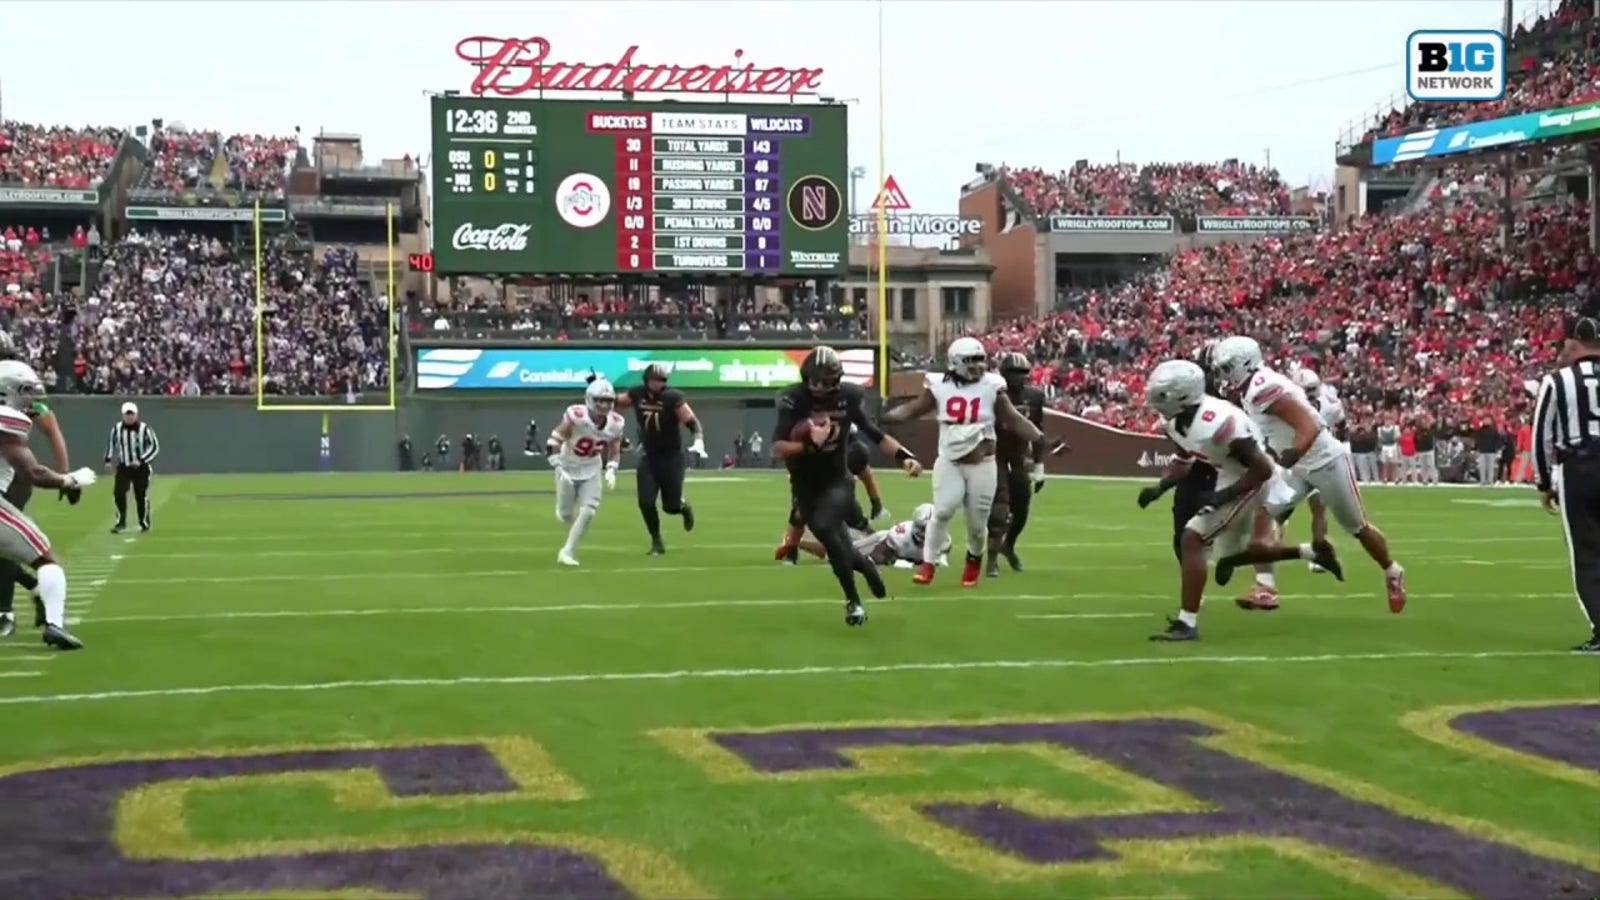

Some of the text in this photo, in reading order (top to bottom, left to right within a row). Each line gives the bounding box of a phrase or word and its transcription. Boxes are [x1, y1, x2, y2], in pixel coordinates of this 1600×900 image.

[455, 36, 823, 94] Budweiser
[446, 109, 498, 133] 12:36
[507, 110, 531, 125] 2ND
[592, 115, 647, 129] BUCKEYES
[662, 118, 738, 129] TEAM STATS
[750, 118, 803, 131] WILDCATS
[626, 138, 641, 152] 30
[667, 140, 729, 152] TOTAL YARDS
[753, 140, 771, 153] 143
[448, 150, 471, 163] OSU
[484, 150, 495, 169] 0
[629, 158, 639, 171] 11
[662, 159, 736, 172] RUSHING YARDS
[484, 172, 495, 191] 0
[662, 178, 735, 191] PASSING YARDS
[627, 196, 643, 211] 1/3
[672, 198, 727, 210] 3RD DOWNS
[752, 197, 771, 211] 4/5
[803, 186, 826, 220] N
[624, 215, 644, 229] 0/0
[664, 217, 736, 229] PENALTIES/YDS
[752, 217, 772, 231] 0/0
[910, 215, 981, 234] Moore
[1057, 218, 1168, 231] WRIGLEYROOFTOPS.COM
[630, 235, 640, 249] 2
[674, 237, 727, 249] 1ST DOWNS
[409, 253, 433, 271] 40
[630, 254, 640, 269] 0
[672, 256, 728, 268] TURNOVERS
[946, 396, 980, 424] 91
[643, 410, 661, 431] 71
